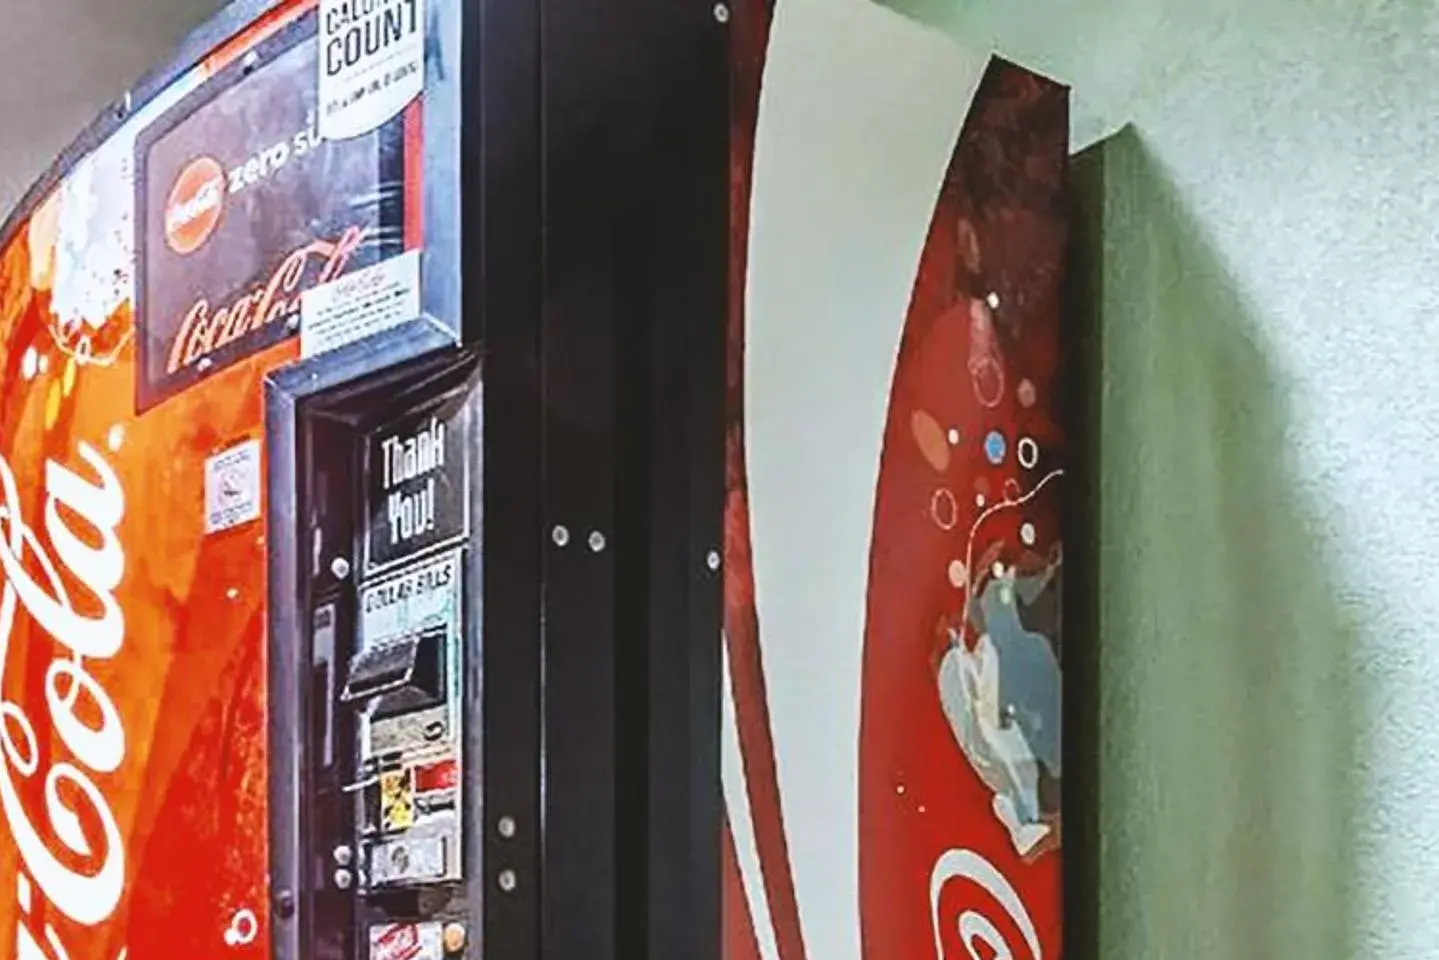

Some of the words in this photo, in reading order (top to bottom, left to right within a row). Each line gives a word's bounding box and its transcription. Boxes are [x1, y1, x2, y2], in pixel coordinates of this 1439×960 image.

[326, 0, 417, 77] COUNT
[228, 141, 290, 193] zero
[381, 416, 445, 490] Thank
[388, 478, 435, 545] You!
